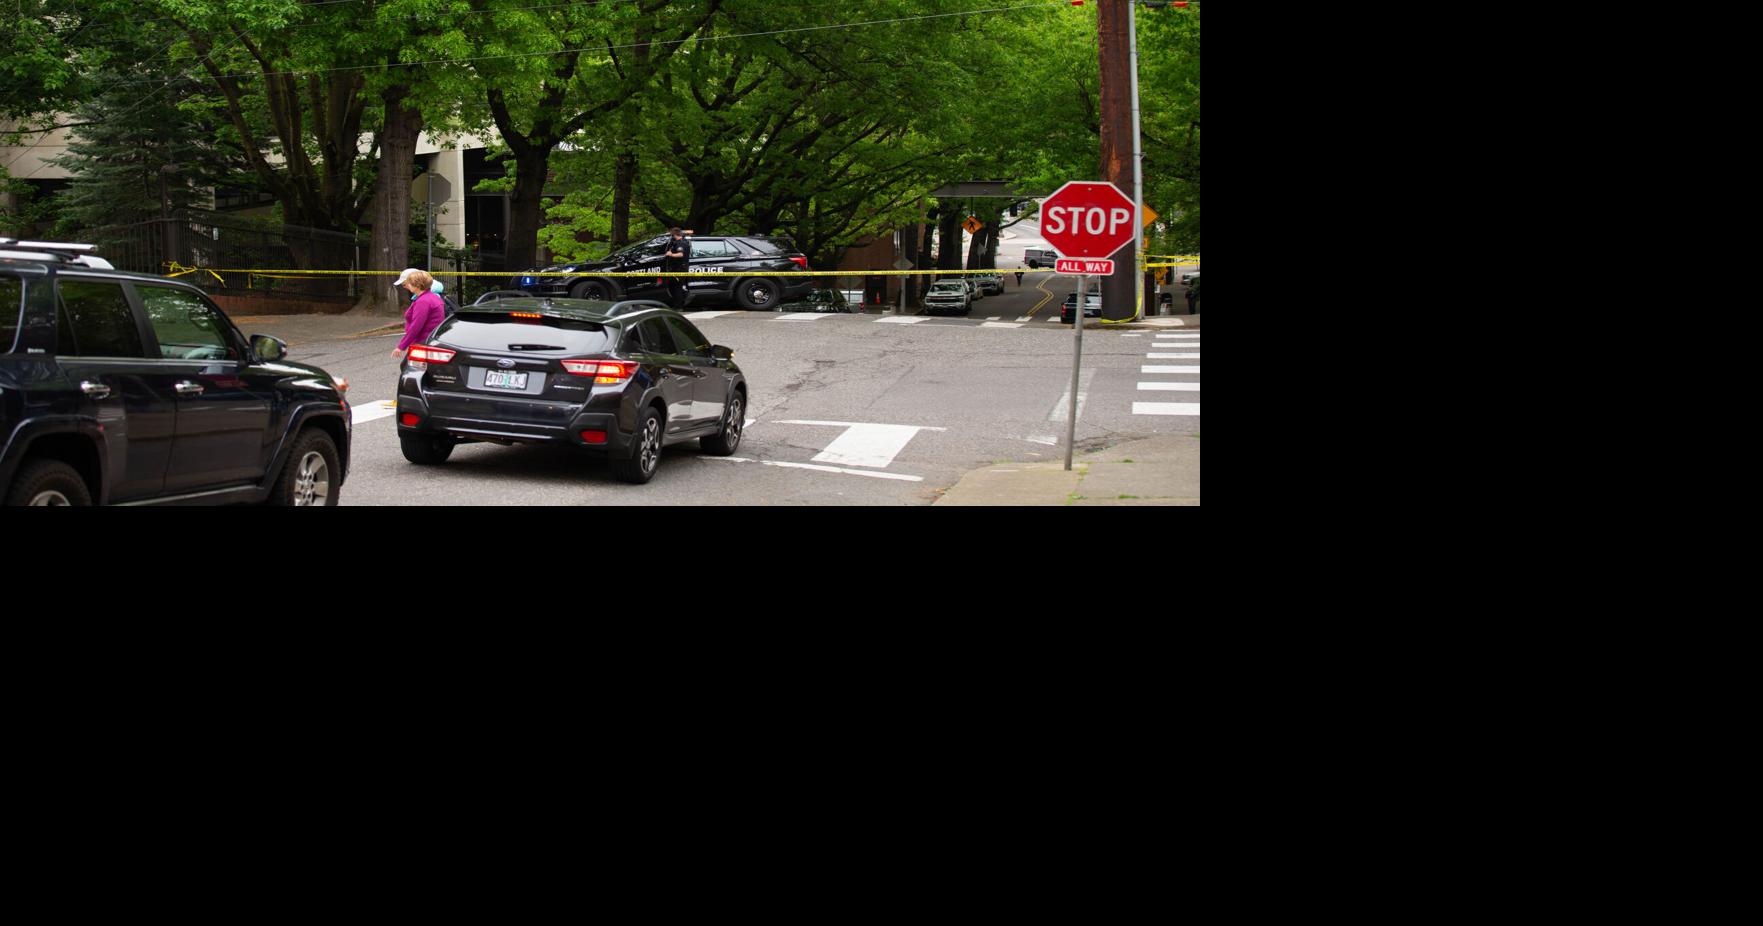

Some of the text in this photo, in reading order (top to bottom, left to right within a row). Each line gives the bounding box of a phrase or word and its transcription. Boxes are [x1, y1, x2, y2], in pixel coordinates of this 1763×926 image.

[1045, 206, 1130, 236] STOP
[626, 266, 661, 277] RTLAND
[688, 266, 723, 274] POLICE
[1060, 261, 1108, 272] ALL WAY
